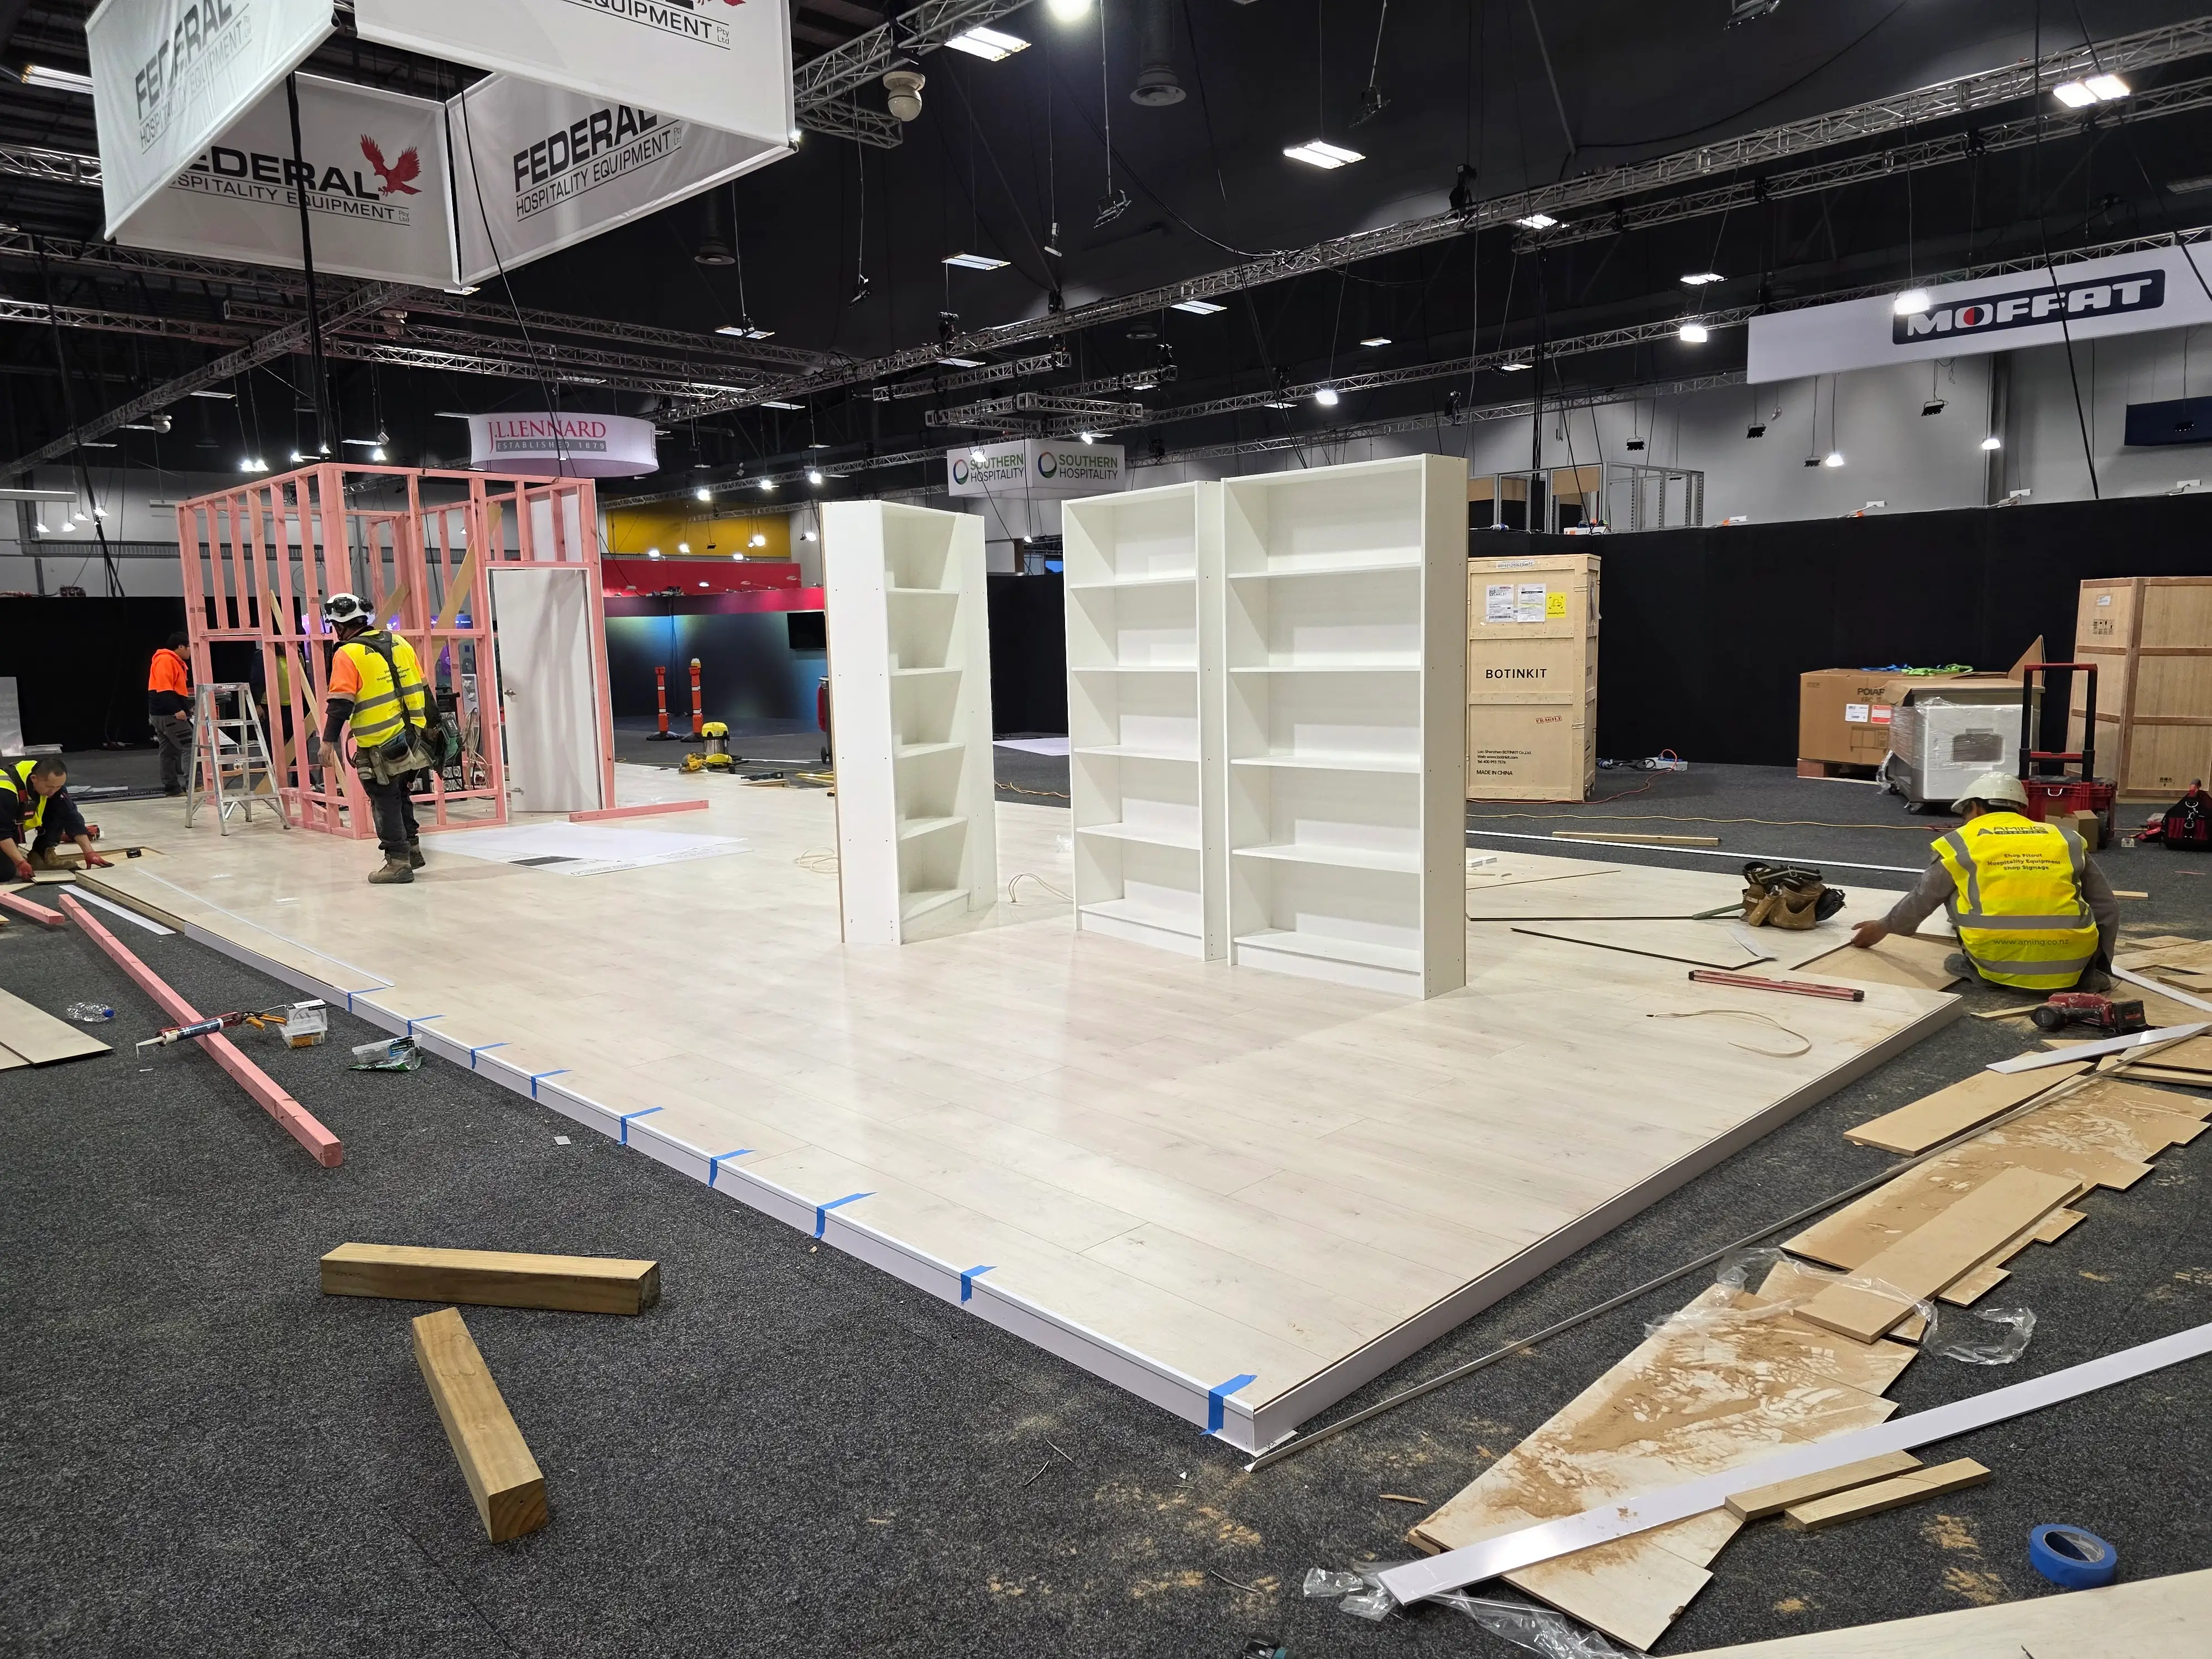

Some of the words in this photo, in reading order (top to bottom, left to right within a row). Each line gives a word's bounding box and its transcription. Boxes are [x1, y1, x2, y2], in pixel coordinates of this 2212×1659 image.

[584, 0, 712, 38] UIPMENT
[717, 27, 729, 37] Pty
[717, 35, 729, 44] Ltd
[135, 0, 232, 120] FEDERAL
[513, 104, 658, 193] FEDERAL
[189, 145, 380, 201] DERAL
[516, 168, 588, 217] HOSPITALITY
[594, 129, 671, 182] EQUIPMENT
[176, 174, 278, 201] SPITALITY
[286, 191, 395, 220] EQUIPMENT
[1907, 278, 2152, 336] MOFFAT
[498, 441, 570, 449] ESTABLISHED
[971, 453, 1024, 470] SOUTHERN
[1058, 453, 1118, 468] SOUTHERN
[971, 467, 1024, 483] HOSPITALITY
[1060, 467, 1118, 480] HOSPITALITY
[1486, 668, 1547, 679] BOTINKIT
